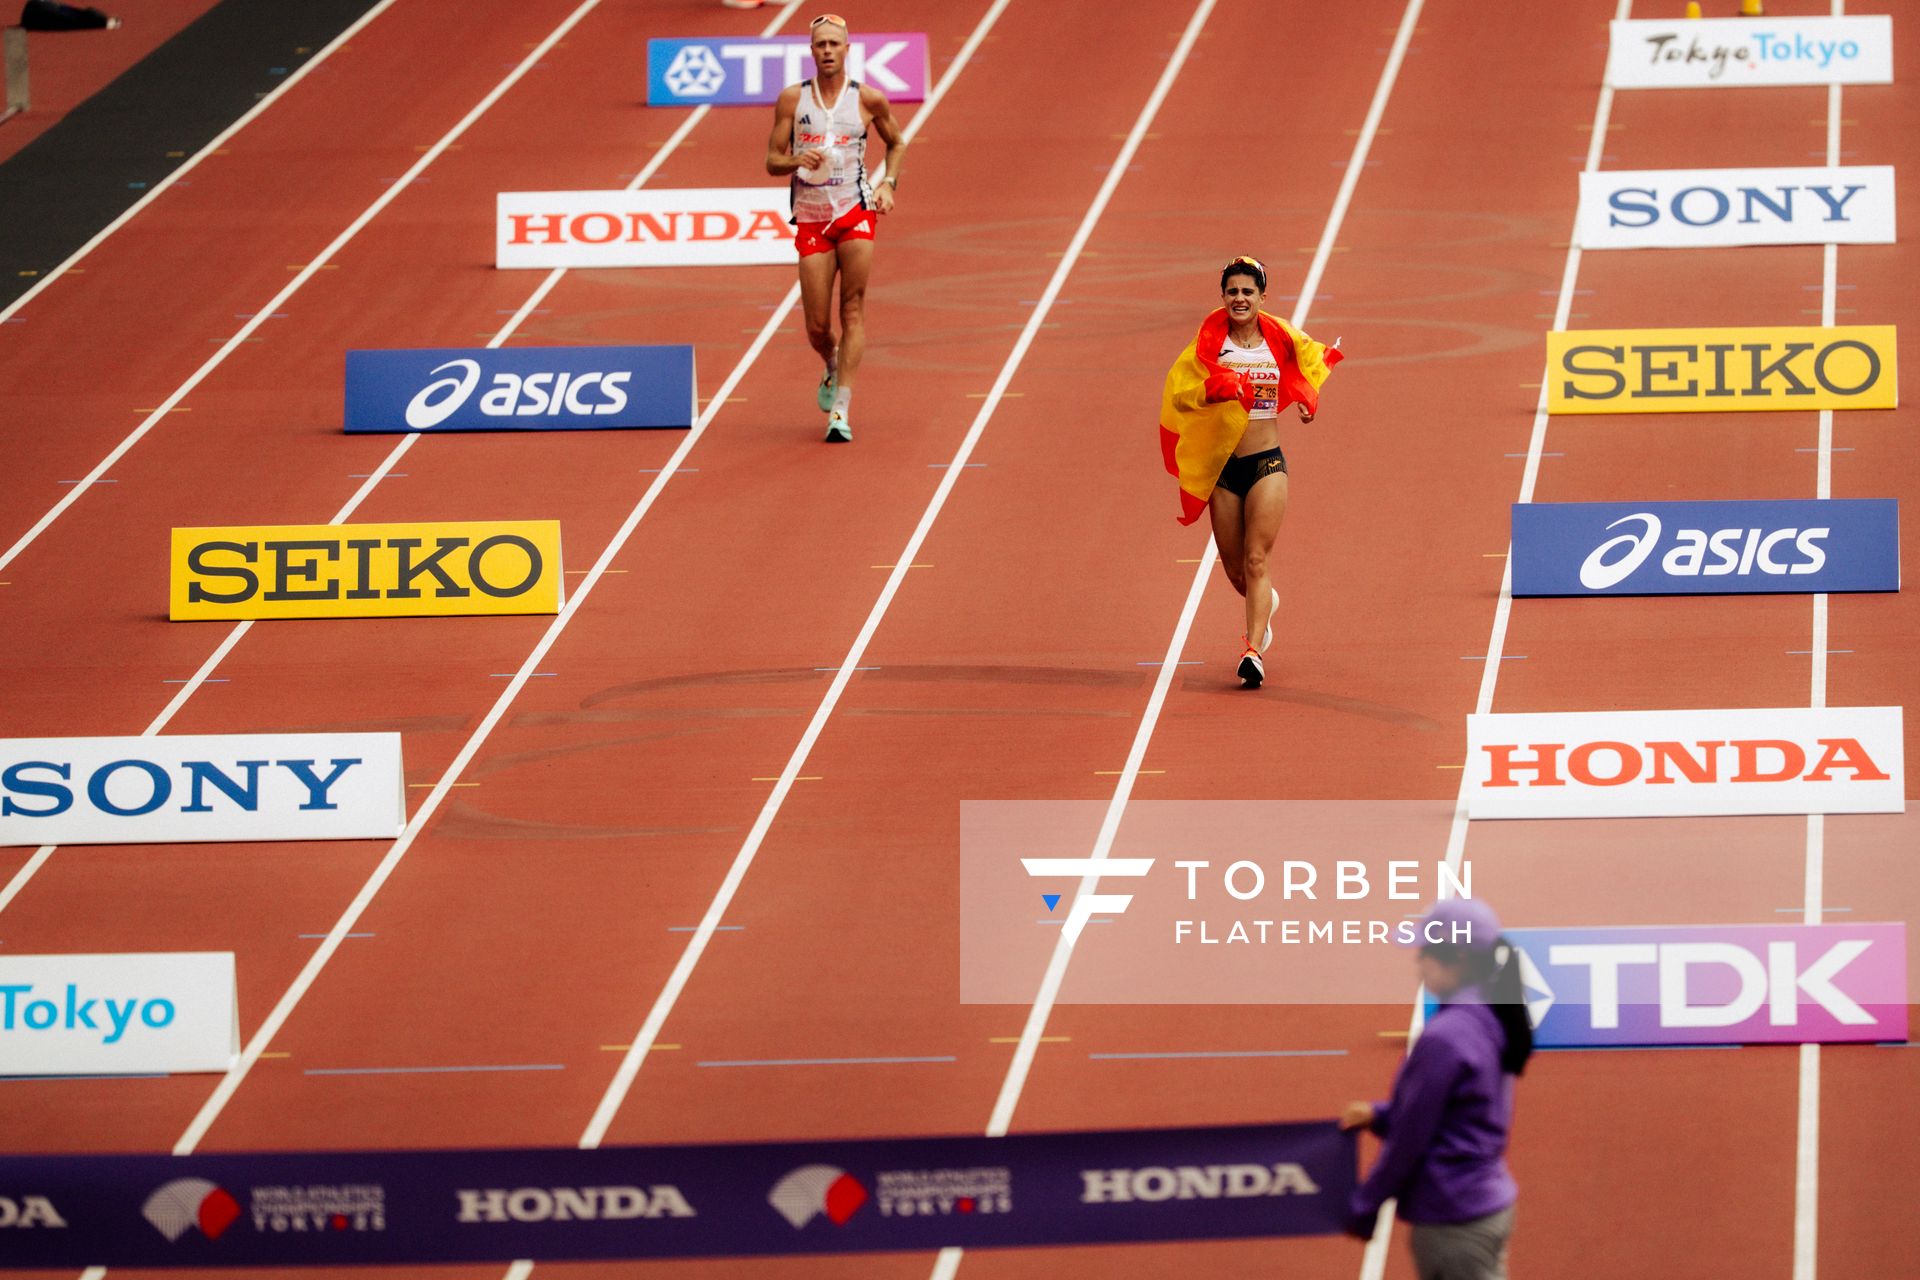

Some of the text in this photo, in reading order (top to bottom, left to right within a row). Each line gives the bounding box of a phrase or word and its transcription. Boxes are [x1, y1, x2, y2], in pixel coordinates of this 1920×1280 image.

[507, 210, 798, 245] HONDA
[1608, 185, 1867, 227] SONY
[1562, 340, 1881, 400] SEIKO
[187, 534, 544, 604] SEIKO
[1, 758, 362, 818] SONY
[1481, 738, 1891, 788] HONDA
[1549, 939, 1879, 1029] TDK
[0, 984, 175, 1045] Tokyo
[457, 1184, 697, 1223] HONDA
[1080, 1162, 1320, 1203] HONDA
